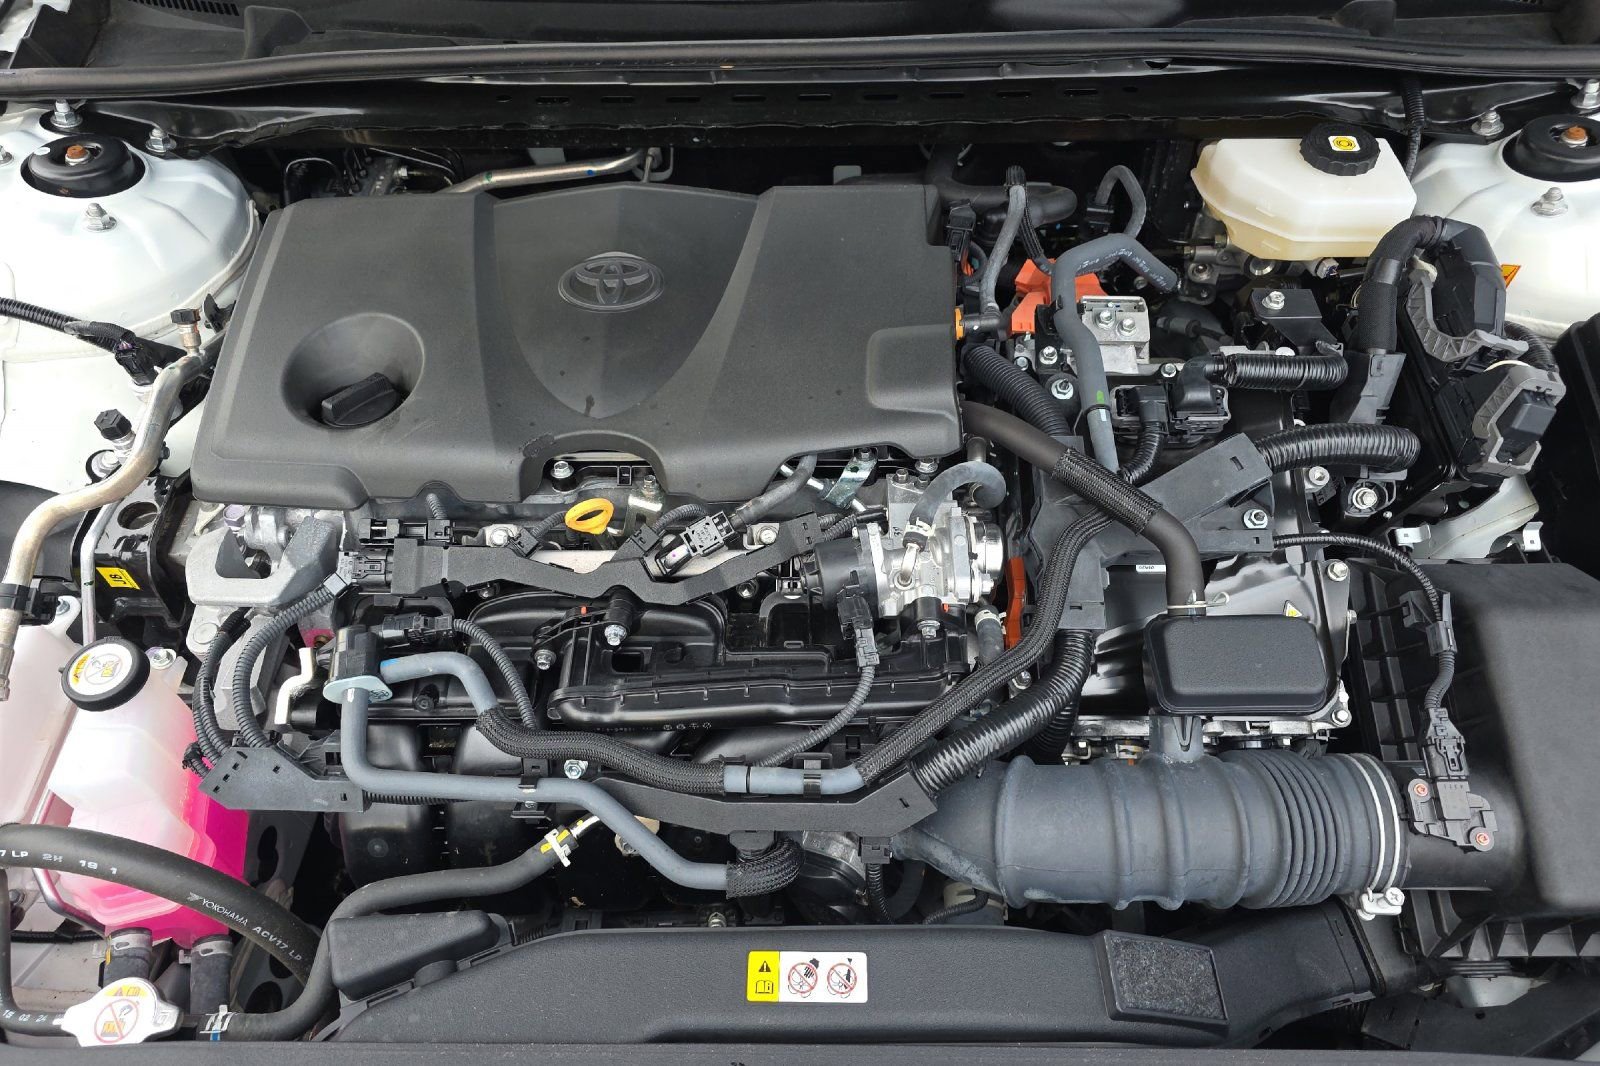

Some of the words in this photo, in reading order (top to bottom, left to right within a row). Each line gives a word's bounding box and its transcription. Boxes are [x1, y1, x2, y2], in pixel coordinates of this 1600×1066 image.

[11, 850, 29, 858] LP
[202, 898, 249, 927] YOKOHAMA
[252, 926, 289, 950] ACV17
[288, 950, 303, 961] LP
